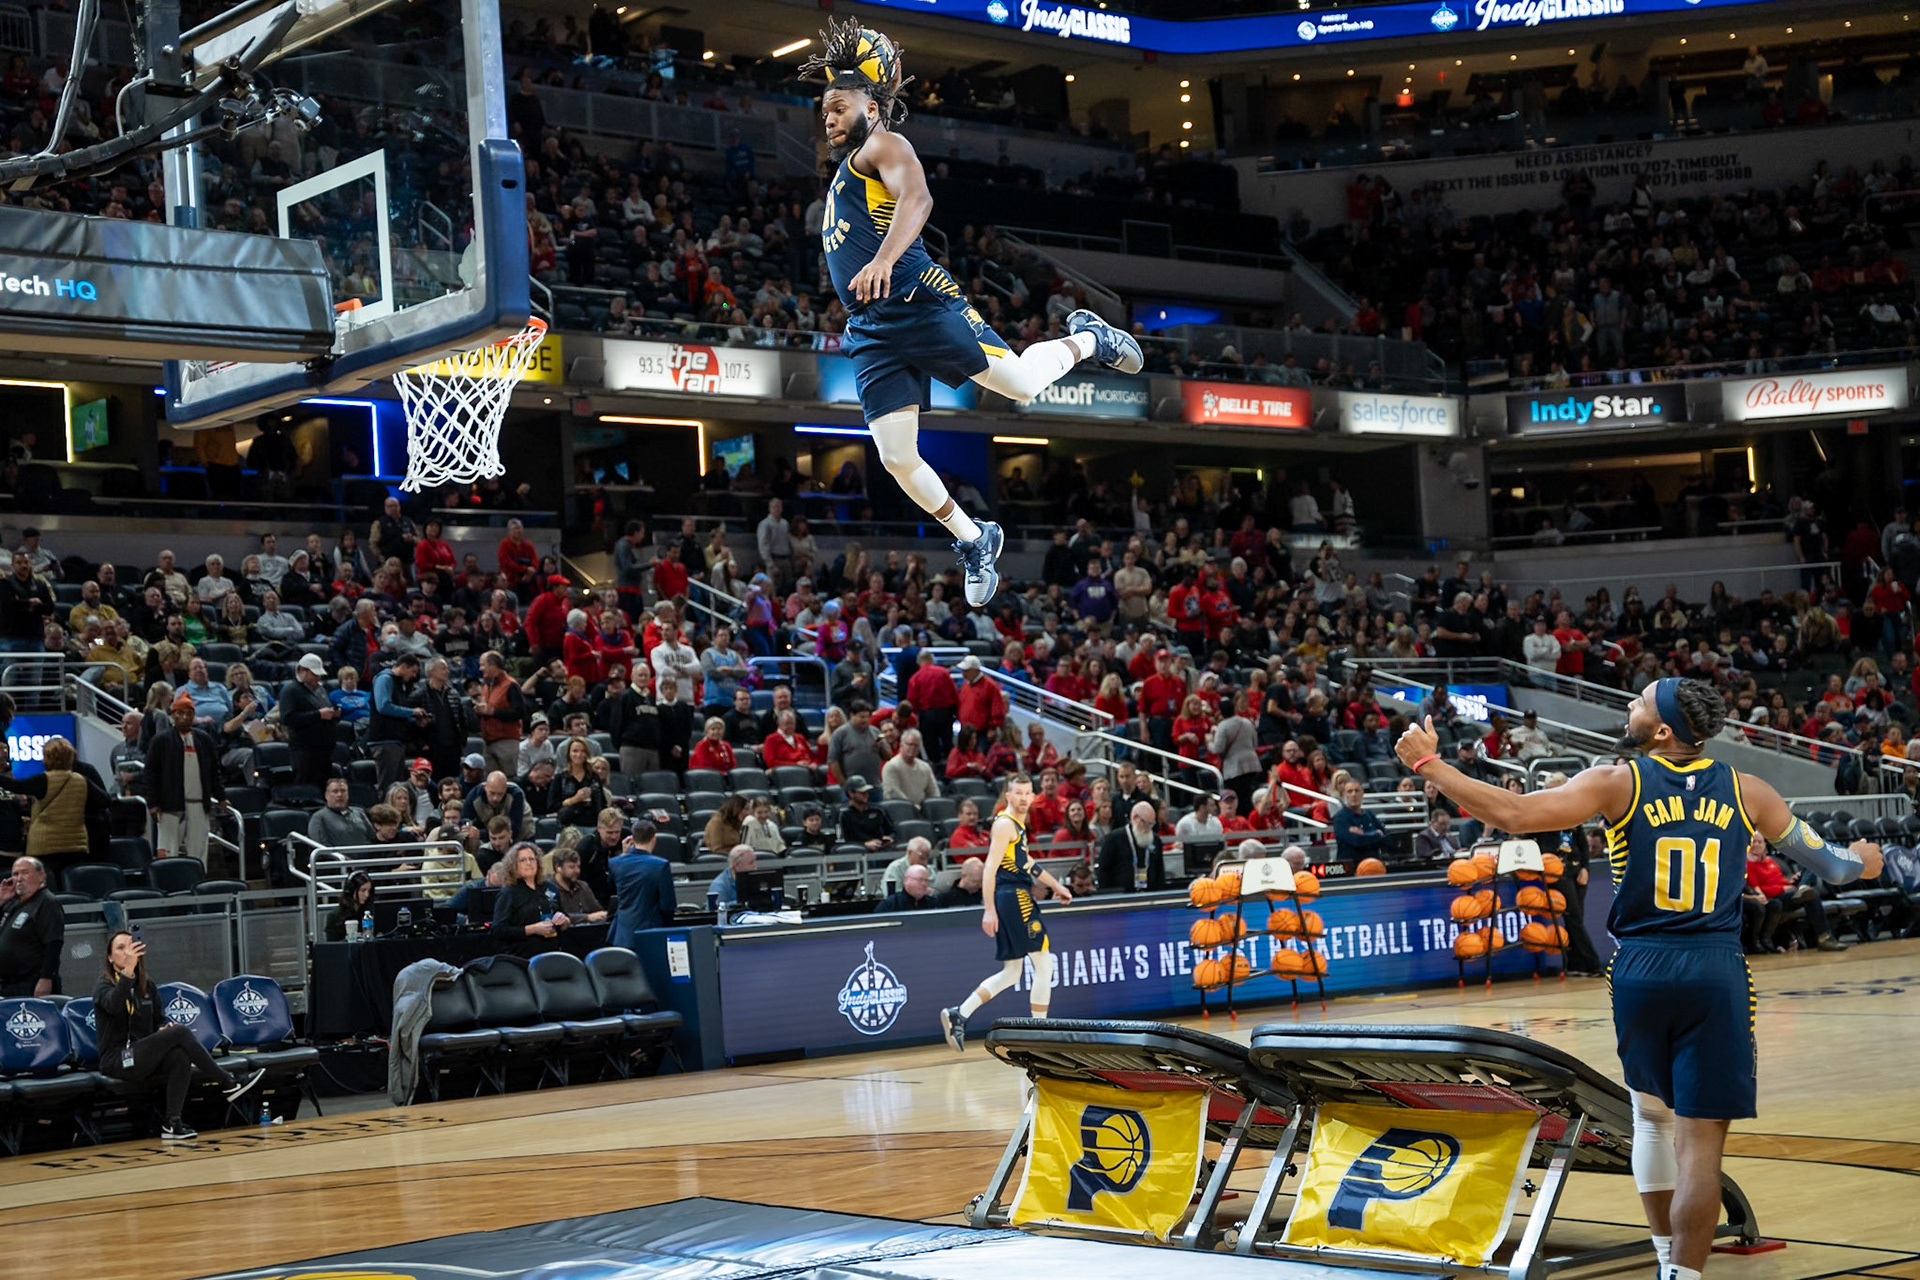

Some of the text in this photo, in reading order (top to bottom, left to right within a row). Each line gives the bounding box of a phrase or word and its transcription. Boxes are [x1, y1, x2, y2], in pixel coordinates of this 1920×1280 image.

[1515, 145, 1652, 169] NEED ASSISTANCE?
[1468, 175, 1493, 189] THE
[1497, 170, 1536, 187] ISSUE
[1553, 163, 1619, 181] LOATION
[1623, 162, 1639, 176] TO
[1646, 170, 1676, 187] 07)
[55, 279, 97, 301] HQ
[639, 356, 664, 375] 93.5
[667, 344, 709, 371] the
[724, 362, 751, 380] 107.5
[677, 366, 721, 394] fan
[1040, 382, 1148, 406] Ruoff MORTGAGE
[1219, 396, 1292, 417] BELLE TIRE
[1745, 378, 1885, 410] Bally SPORTS
[1353, 398, 1447, 430] salesforce
[8, 734, 63, 761] ASS
[1643, 795, 1735, 830] CAM JAM
[1654, 836, 1721, 914] 01
[1014, 944, 1149, 992] NIANA'S
[840, 987, 906, 1011] IndyCLASSIC
[31, 1114, 412, 1168] PURDUE
